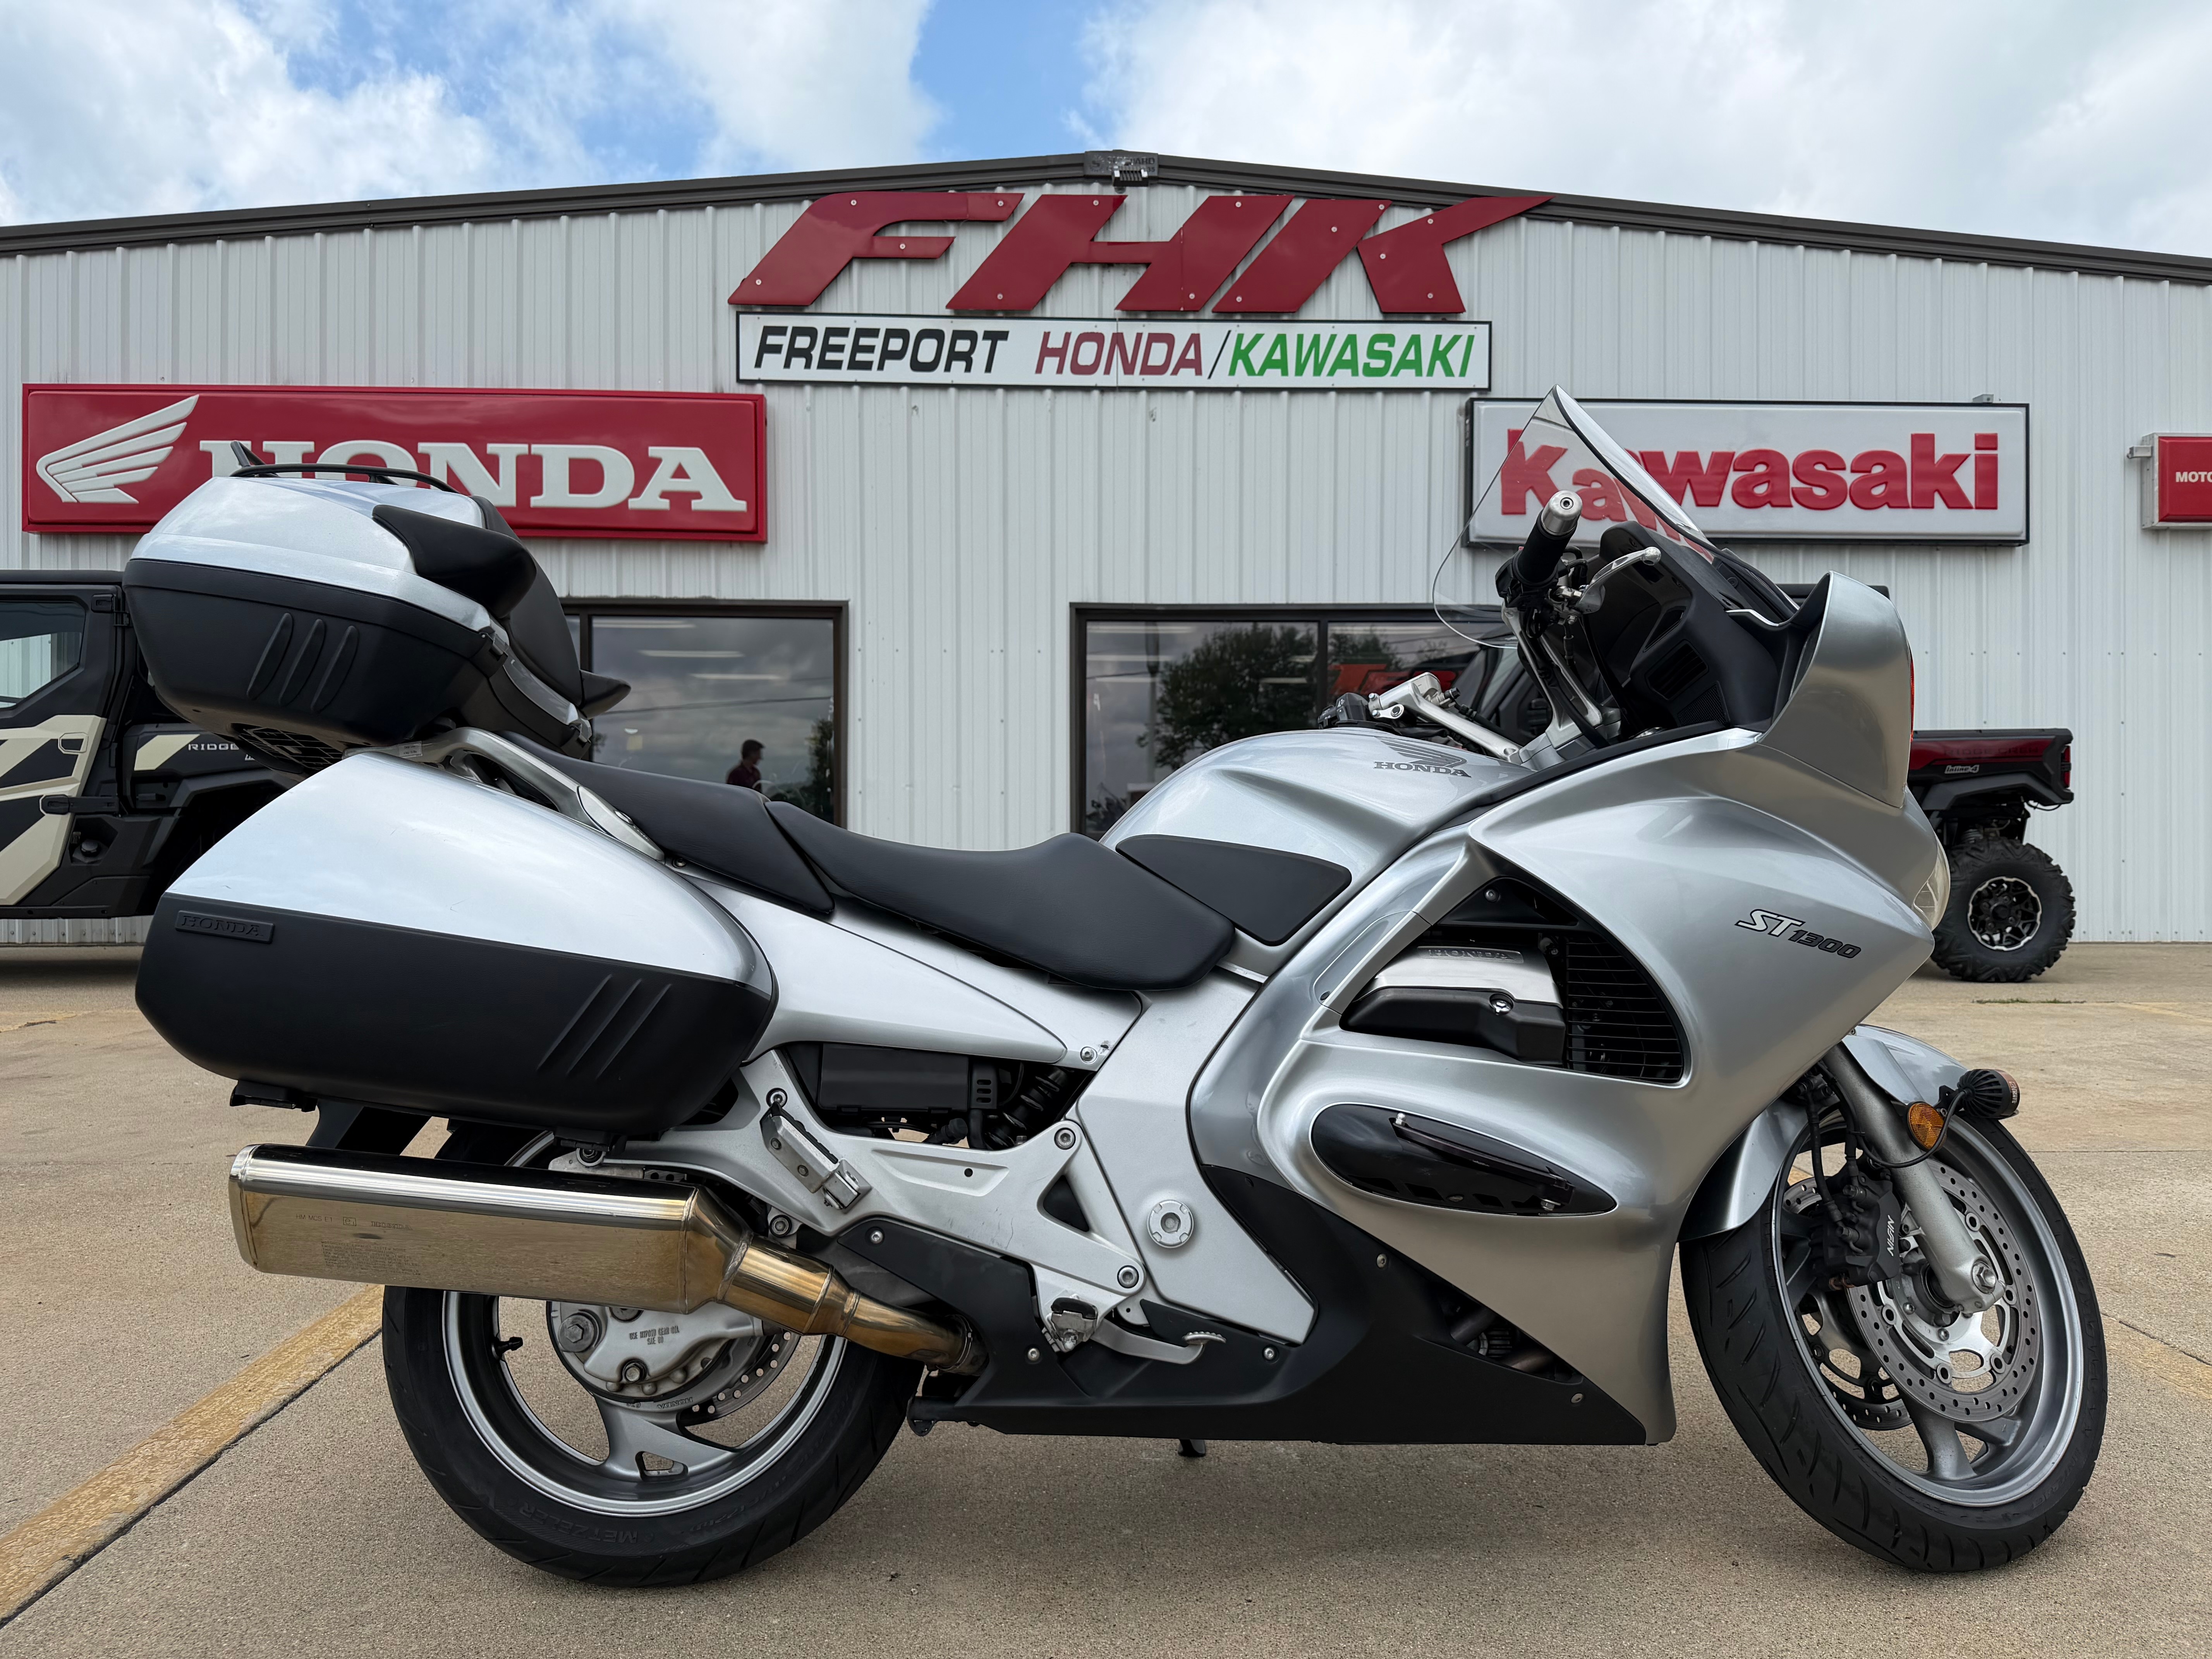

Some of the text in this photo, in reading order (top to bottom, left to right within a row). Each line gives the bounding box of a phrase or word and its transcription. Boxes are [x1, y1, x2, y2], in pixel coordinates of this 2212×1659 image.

[728, 191, 1555, 313] FHK
[754, 325, 1009, 374] FREEPORT
[199, 440, 747, 512] HONDA
[1501, 428, 1998, 519] Kawasaki
[1373, 761, 1472, 778] HONDA
[182, 915, 264, 936] HONDA
[1428, 950, 1515, 960] HONDA
[371, 1221, 413, 1230] HONDA
[658, 1327, 670, 1336] GEAR
[671, 1325, 680, 1334] OIL
[658, 1396, 693, 1409] HONDA
[519, 1501, 638, 1544] METZELER
